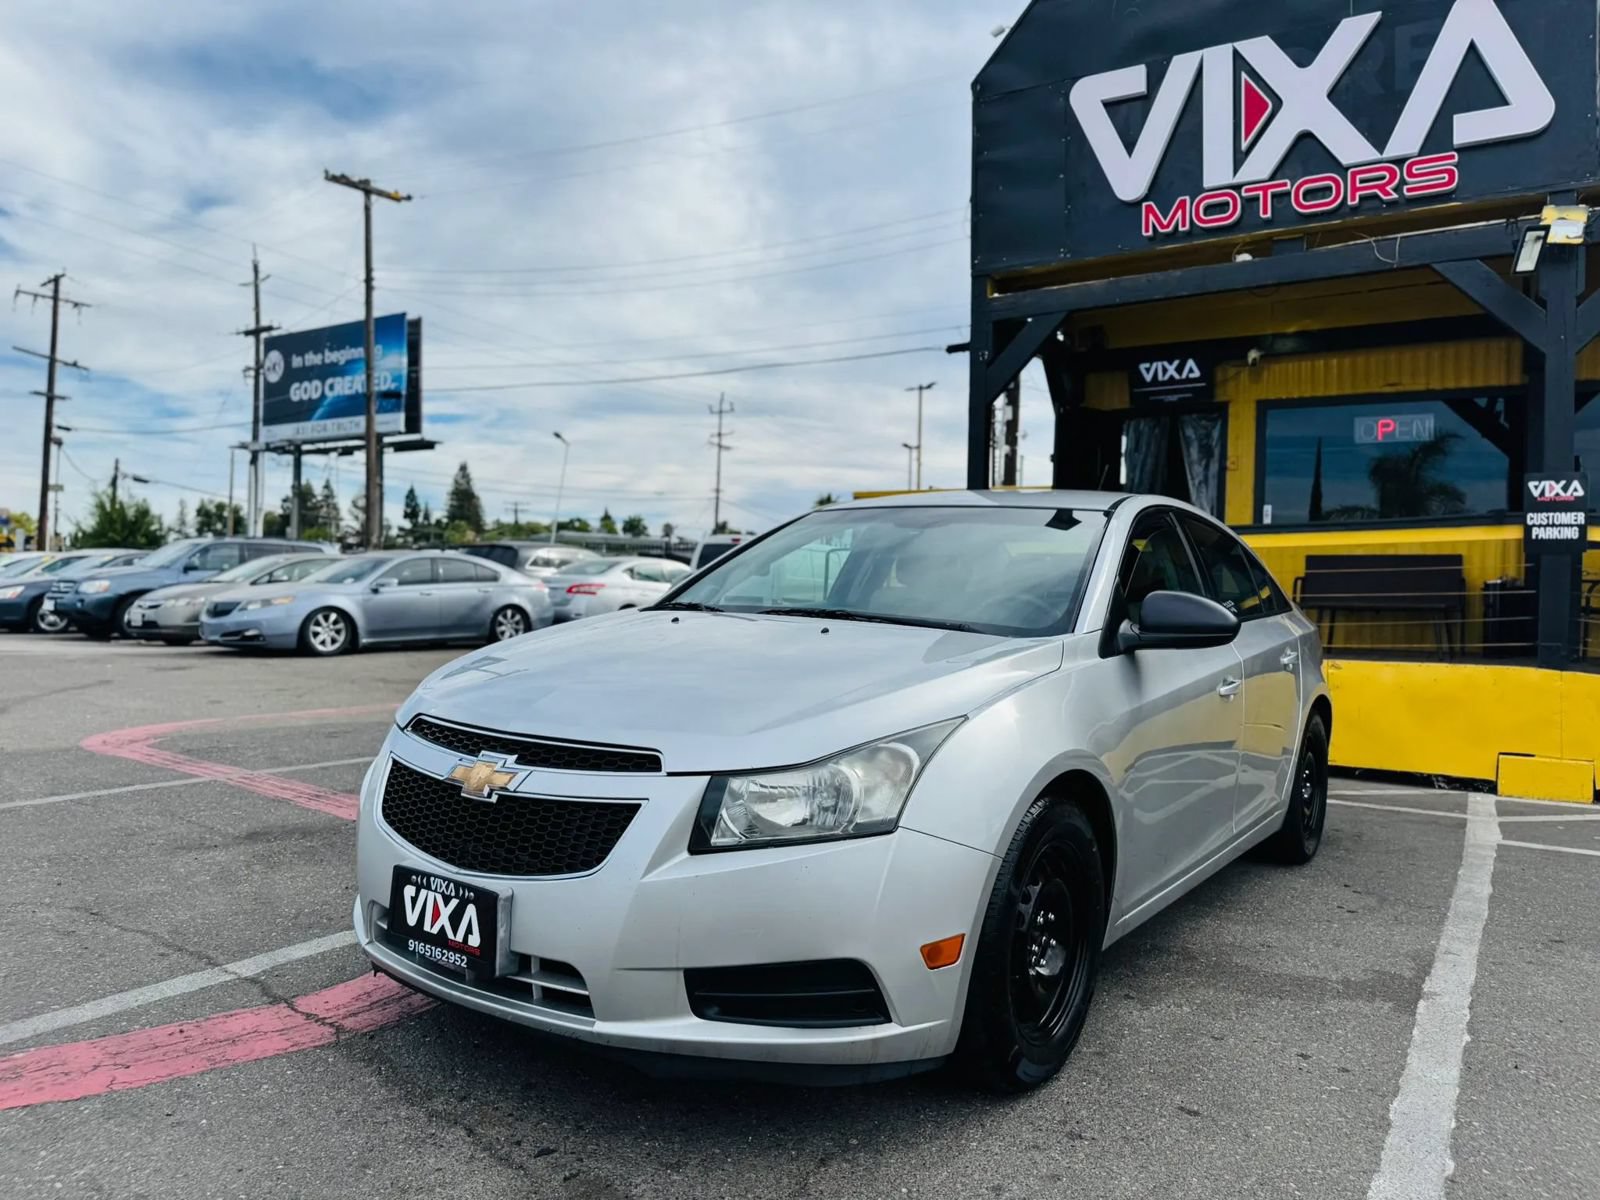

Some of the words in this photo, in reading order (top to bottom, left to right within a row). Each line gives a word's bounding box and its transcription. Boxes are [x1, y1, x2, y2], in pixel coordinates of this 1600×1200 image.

[1069, 0, 1555, 202] VIXA
[1142, 151, 1458, 237] MOTORS
[292, 354, 304, 369] In
[304, 350, 323, 367] the
[1138, 358, 1201, 383] VIXA
[289, 379, 323, 402] GOD
[1360, 417, 1430, 441] OPEN
[1527, 479, 1585, 498] VIXA
[1526, 511, 1586, 526] CUSTOMER
[1531, 526, 1580, 540] PARKING
[429, 876, 456, 897] VIXA
[403, 884, 481, 948] VIXA
[408, 939, 468, 968] 9165162952
[447, 939, 481, 956] MOTORS
